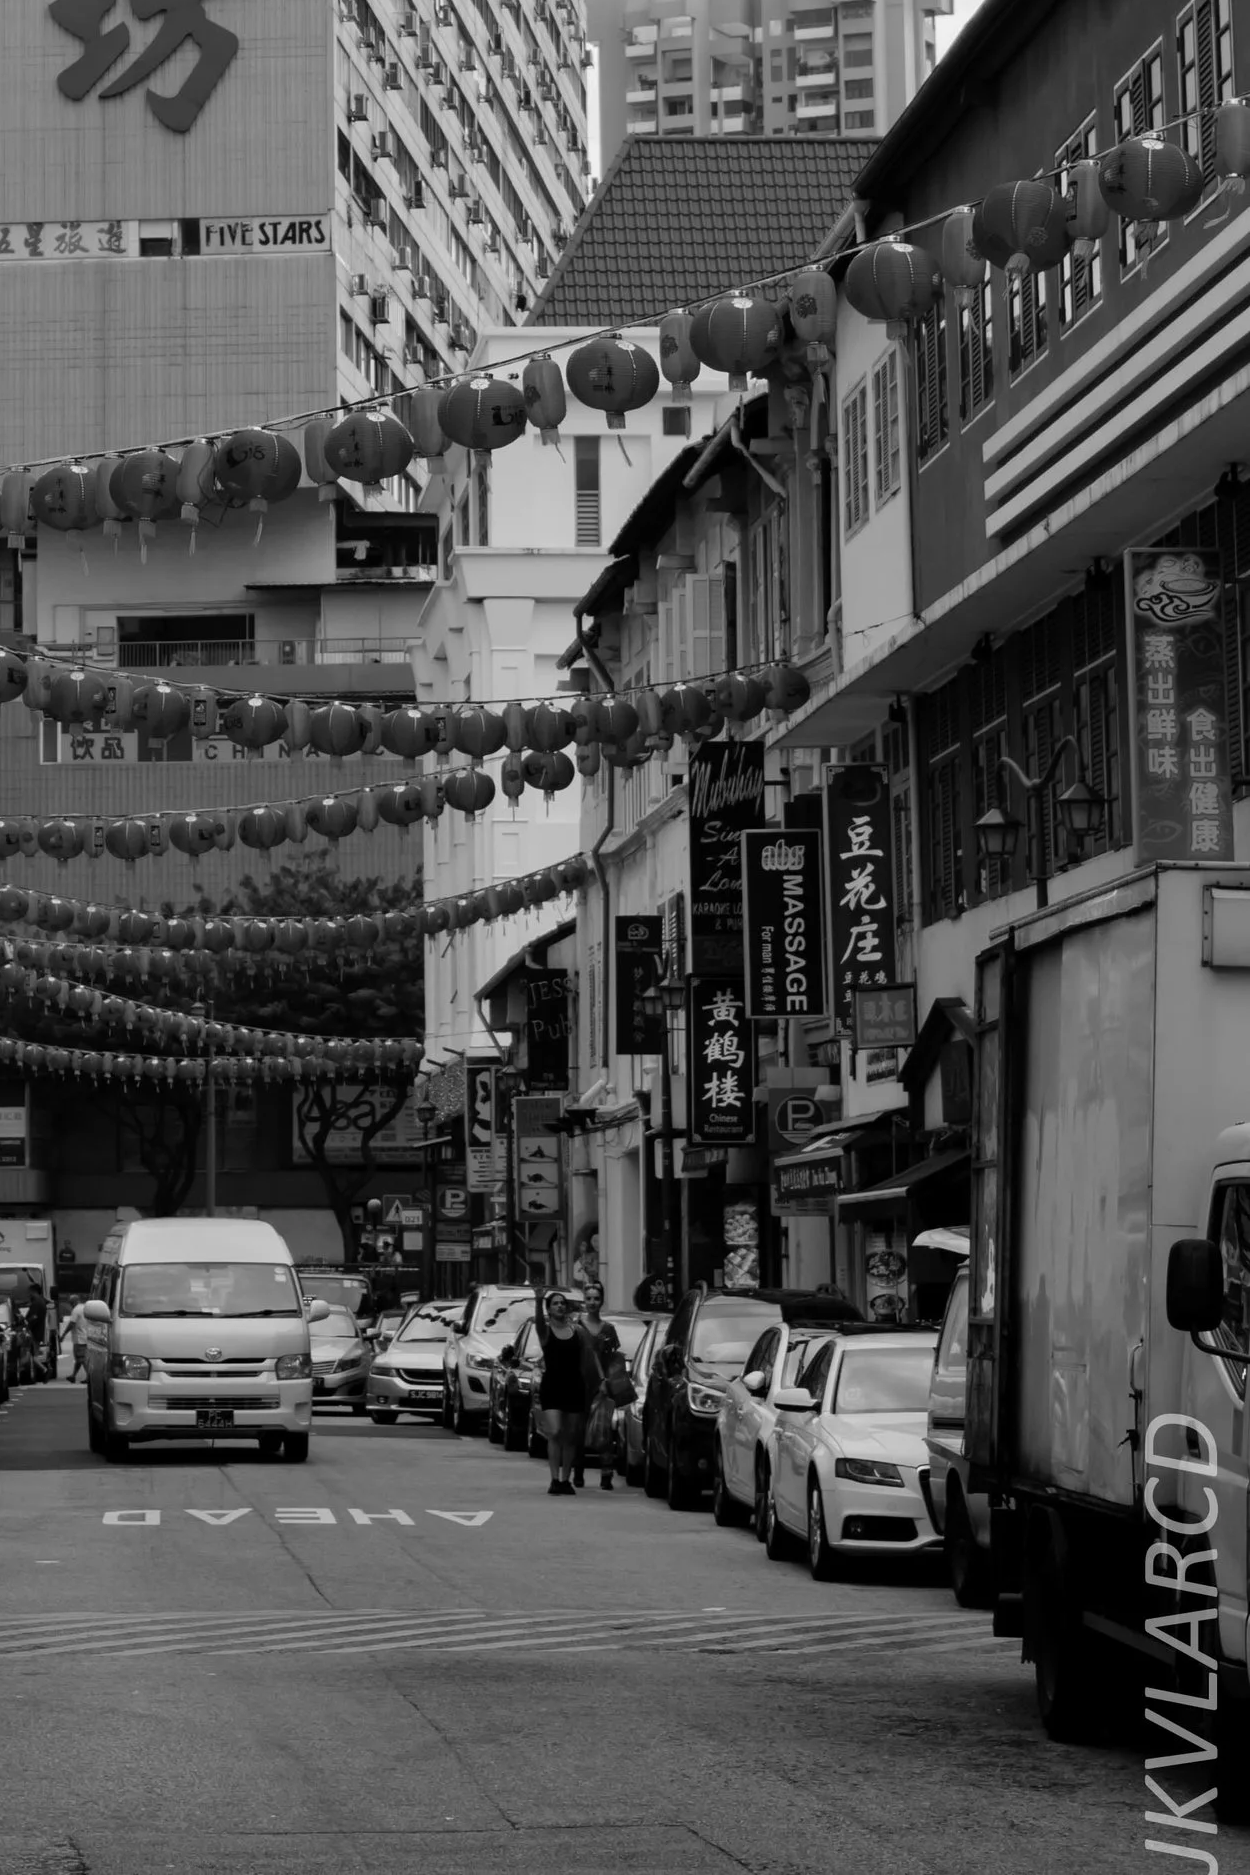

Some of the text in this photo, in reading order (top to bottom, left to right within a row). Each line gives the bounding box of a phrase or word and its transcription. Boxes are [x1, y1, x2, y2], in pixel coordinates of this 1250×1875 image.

[204, 219, 327, 248] FIVE STARS
[1144, 634, 1179, 779] 蒸出鲜味
[70, 736, 125, 761] 饮品
[1186, 707, 1220, 853] 食出健康
[700, 820, 742, 844] Sin
[699, 869, 742, 891] Lon
[839, 815, 888, 965] 豆花庄
[761, 925, 775, 942] For
[782, 874, 808, 1012] MASSAGE
[761, 943, 773, 964] man
[701, 987, 746, 1109] 黄鹤楼
[709, 1112, 739, 1123] Chinese
[101, 1507, 495, 1527] AHEAD
